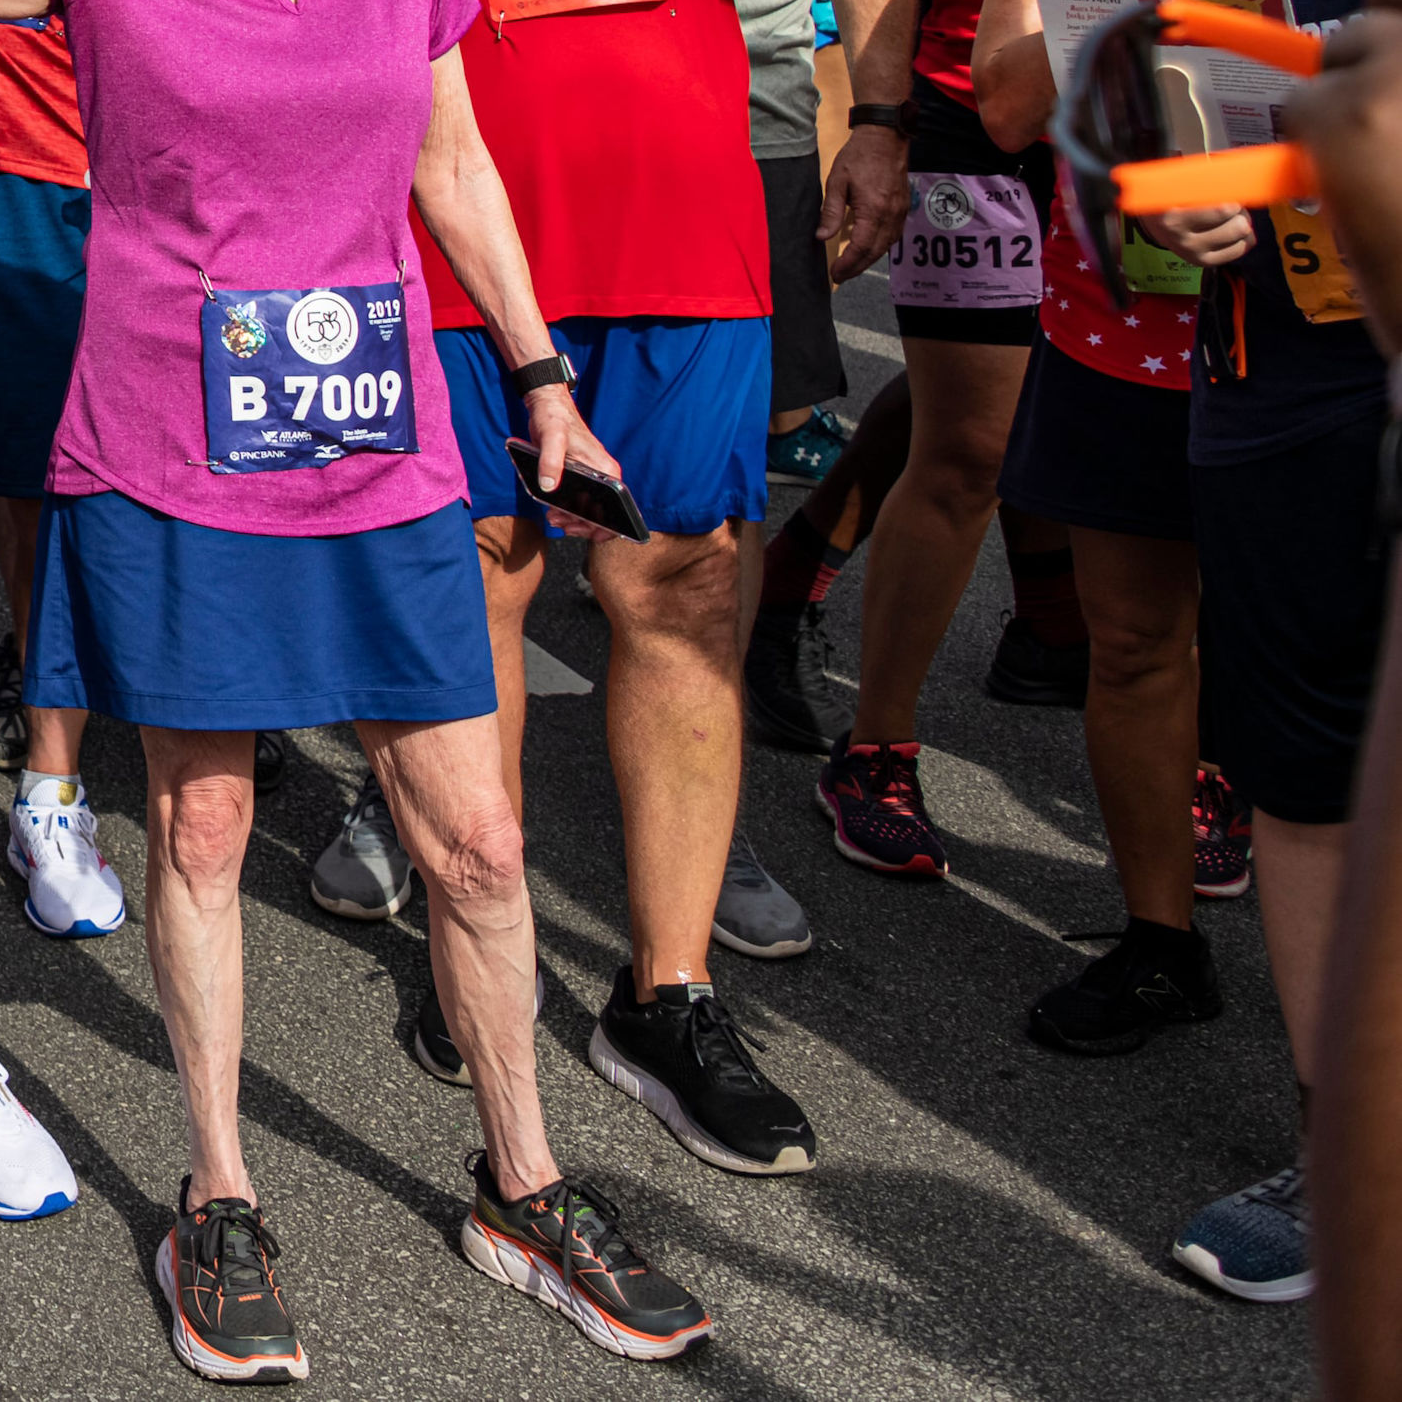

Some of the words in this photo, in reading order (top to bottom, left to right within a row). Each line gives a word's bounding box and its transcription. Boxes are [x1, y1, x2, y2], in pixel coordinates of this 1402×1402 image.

[985, 189, 1021, 202] 2019
[913, 234, 1034, 269] 30512
[1283, 233, 1320, 275] S
[366, 299, 401, 319] 2019
[229, 376, 268, 422] B
[284, 370, 402, 422] 7009
